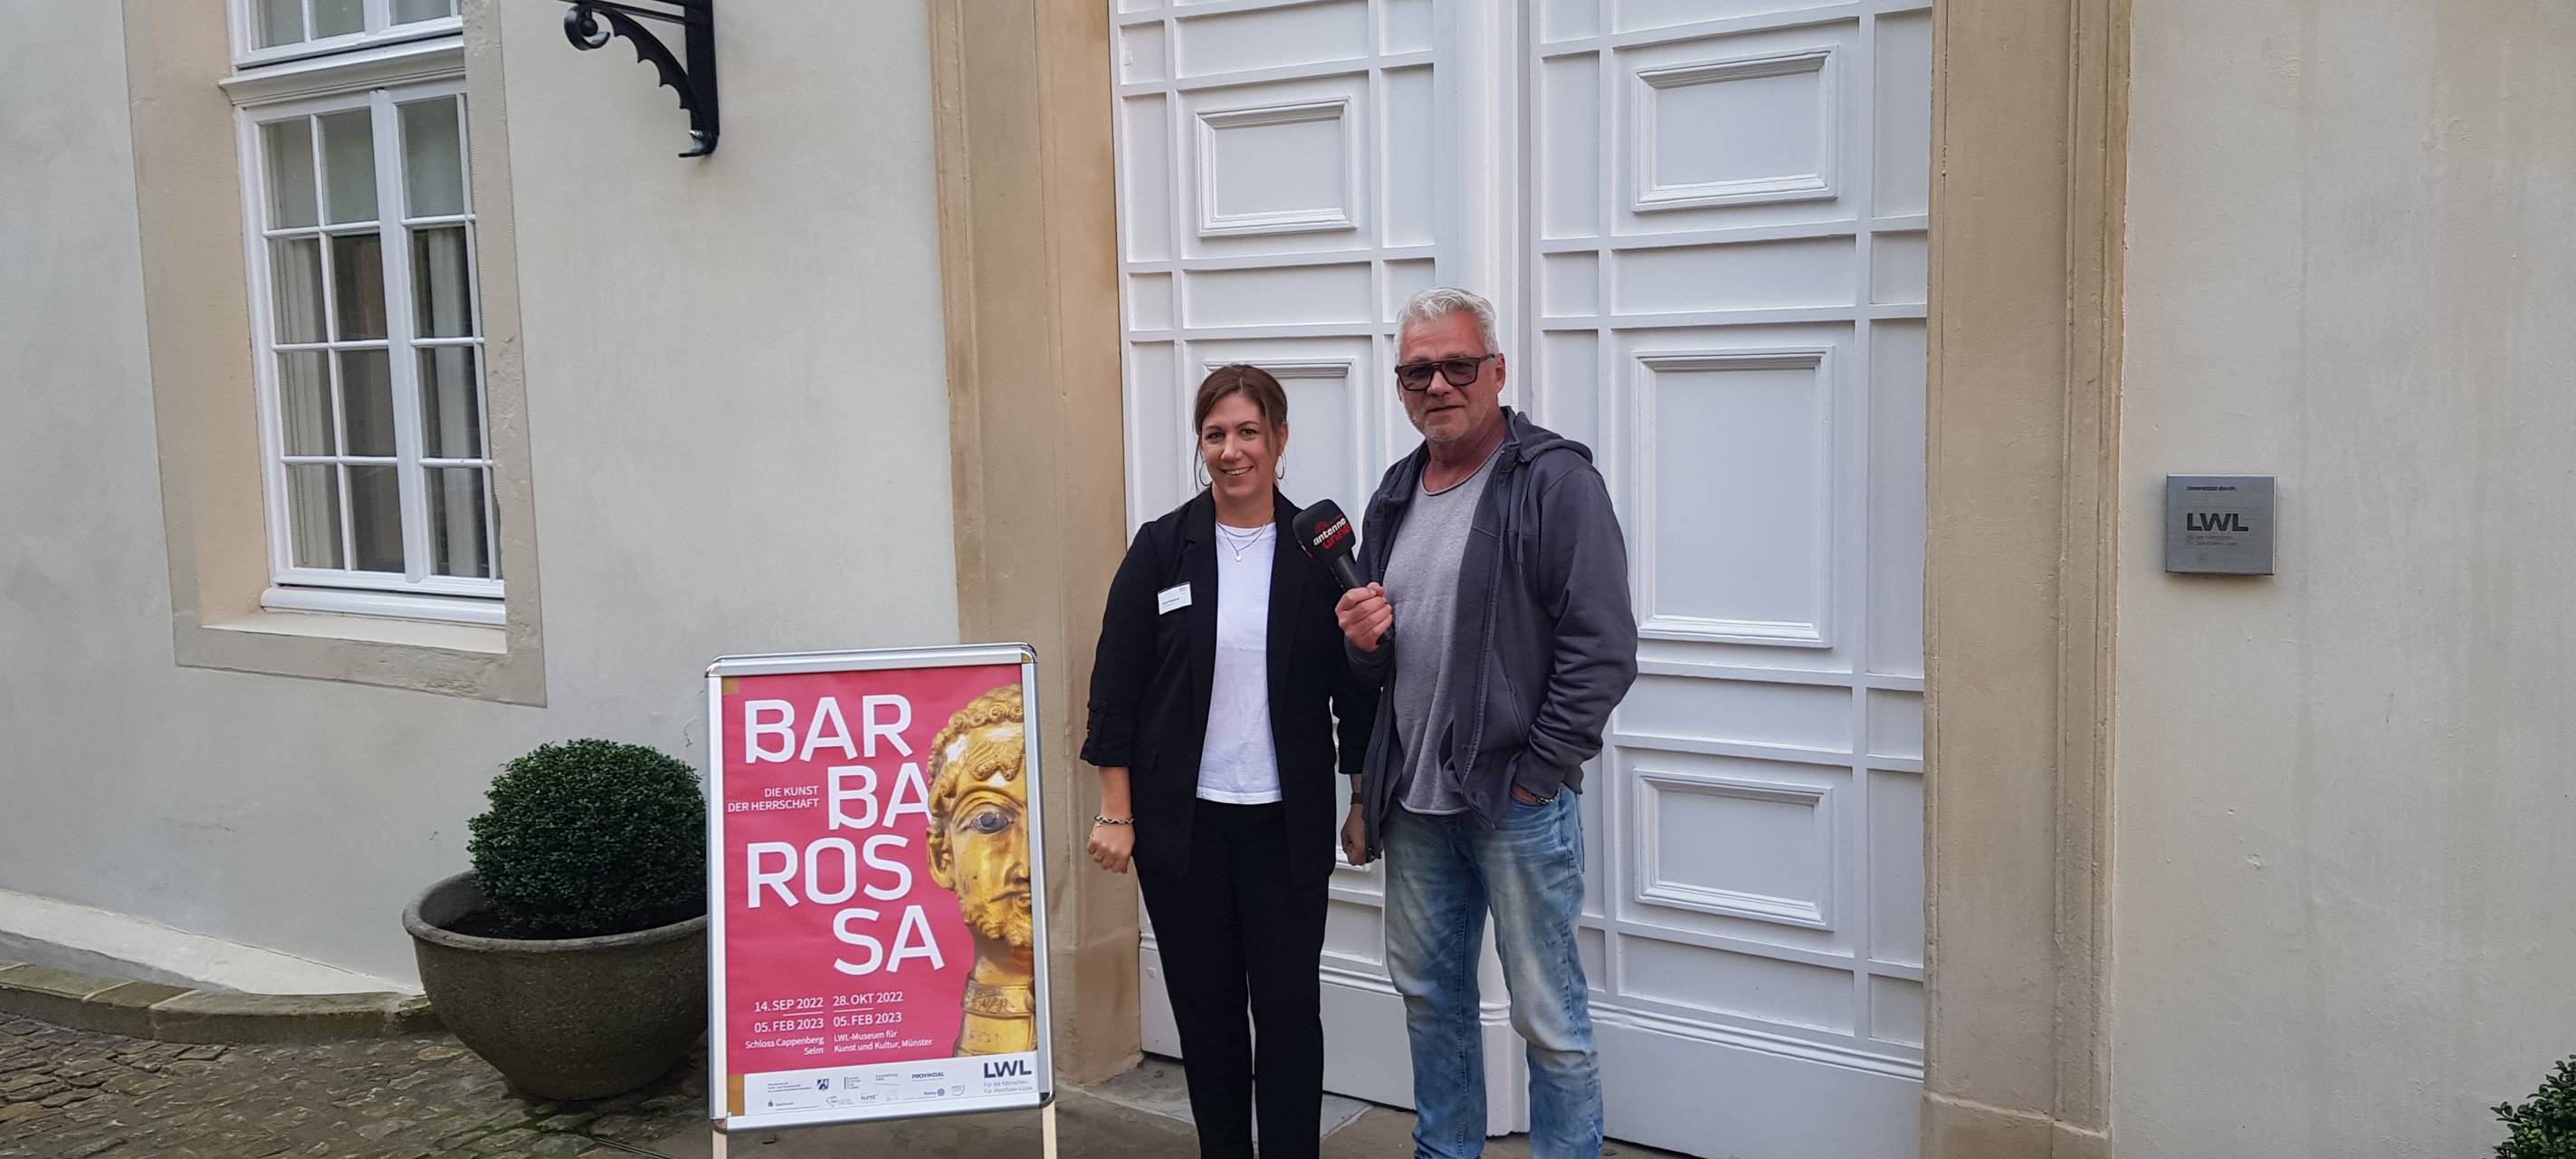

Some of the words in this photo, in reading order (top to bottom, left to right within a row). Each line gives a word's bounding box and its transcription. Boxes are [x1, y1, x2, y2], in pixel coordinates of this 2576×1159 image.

[2187, 512, 2248, 532] LWL
[1312, 517, 1347, 546] antenne
[744, 694, 913, 764] BAR
[764, 788, 781, 798] DIE
[784, 785, 819, 796] KUNST
[827, 762, 932, 830] BA
[728, 802, 749, 812] DER
[751, 798, 820, 811] HERRSCHAFT
[747, 834, 912, 908] ROS
[832, 905, 945, 976] SA
[797, 997, 824, 1010] 2022
[876, 991, 903, 1003] 2022
[797, 1017, 824, 1030] 2023
[875, 1011, 902, 1024] 2023
[745, 1039, 776, 1049] Schloss
[776, 1036, 825, 1048] Cappenberg
[834, 1031, 884, 1042] LWL-Museum
[885, 1030, 898, 1039] für
[834, 1044, 856, 1053] Kunst
[857, 1041, 873, 1050] und
[902, 1038, 933, 1048] Münster
[984, 1059, 1032, 1078] LWL
